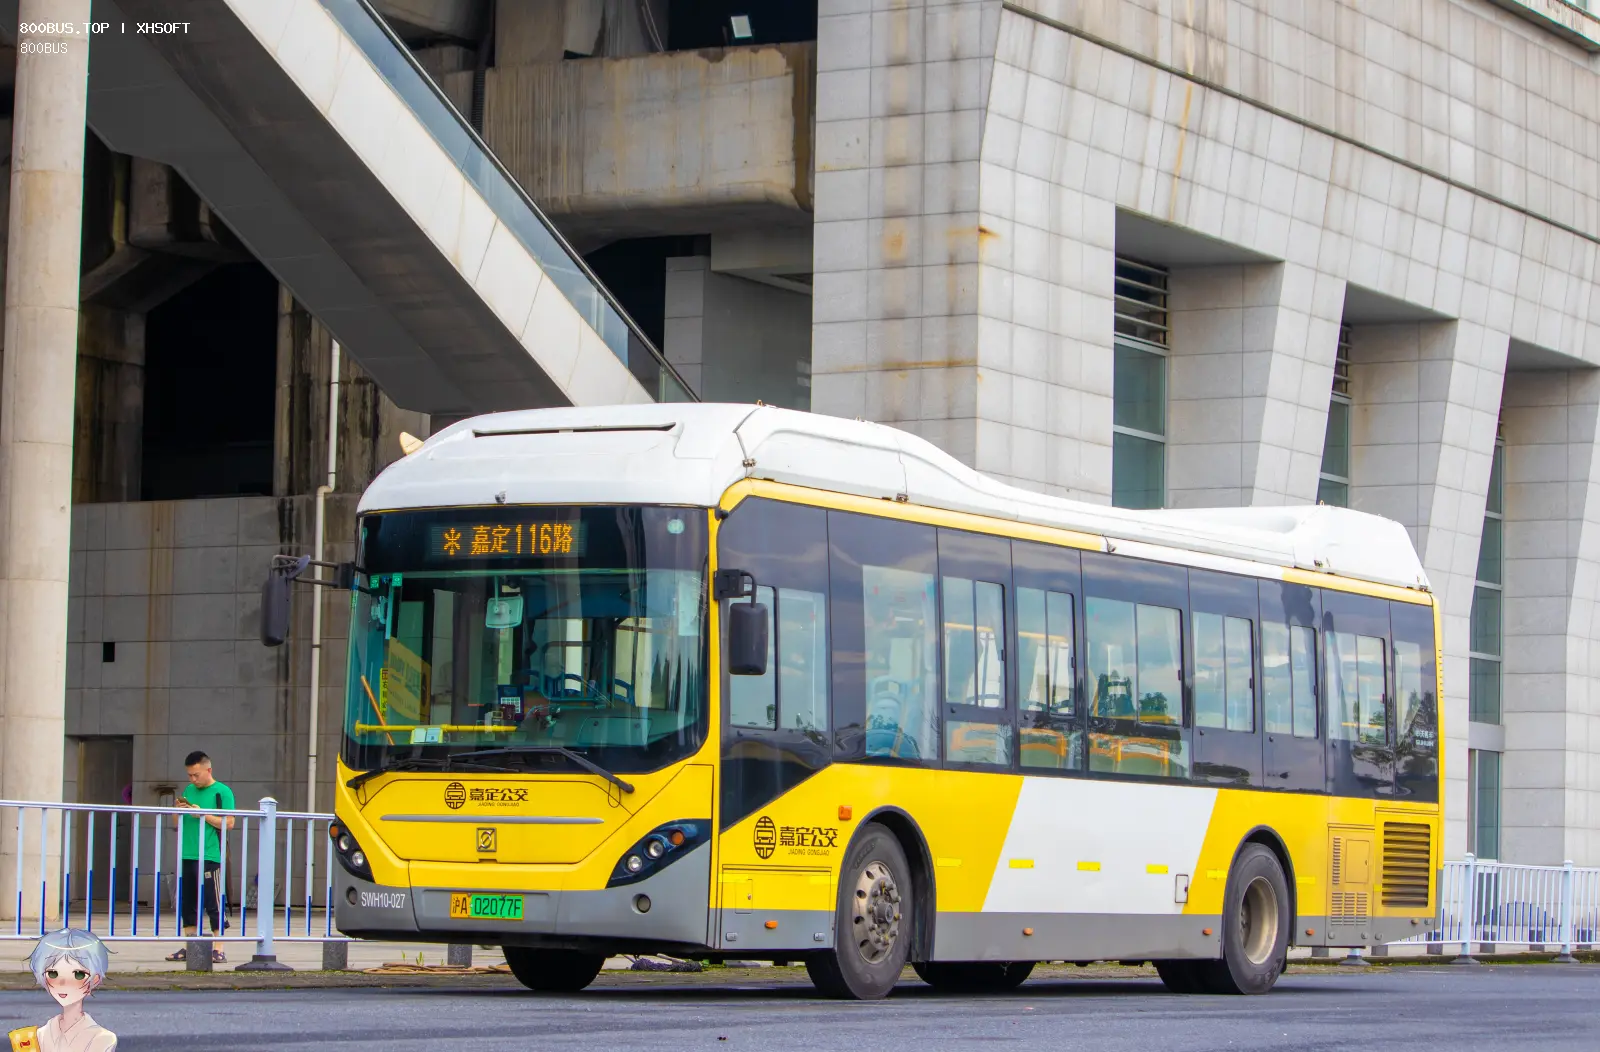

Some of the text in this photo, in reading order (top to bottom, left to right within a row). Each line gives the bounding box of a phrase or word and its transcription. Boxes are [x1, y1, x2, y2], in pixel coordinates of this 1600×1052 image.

[470, 523, 573, 555] 嘉定116路
[469, 788, 529, 801] 嘉定公交
[779, 826, 838, 847] 嘉定公交
[361, 892, 406, 909] SWH10-027
